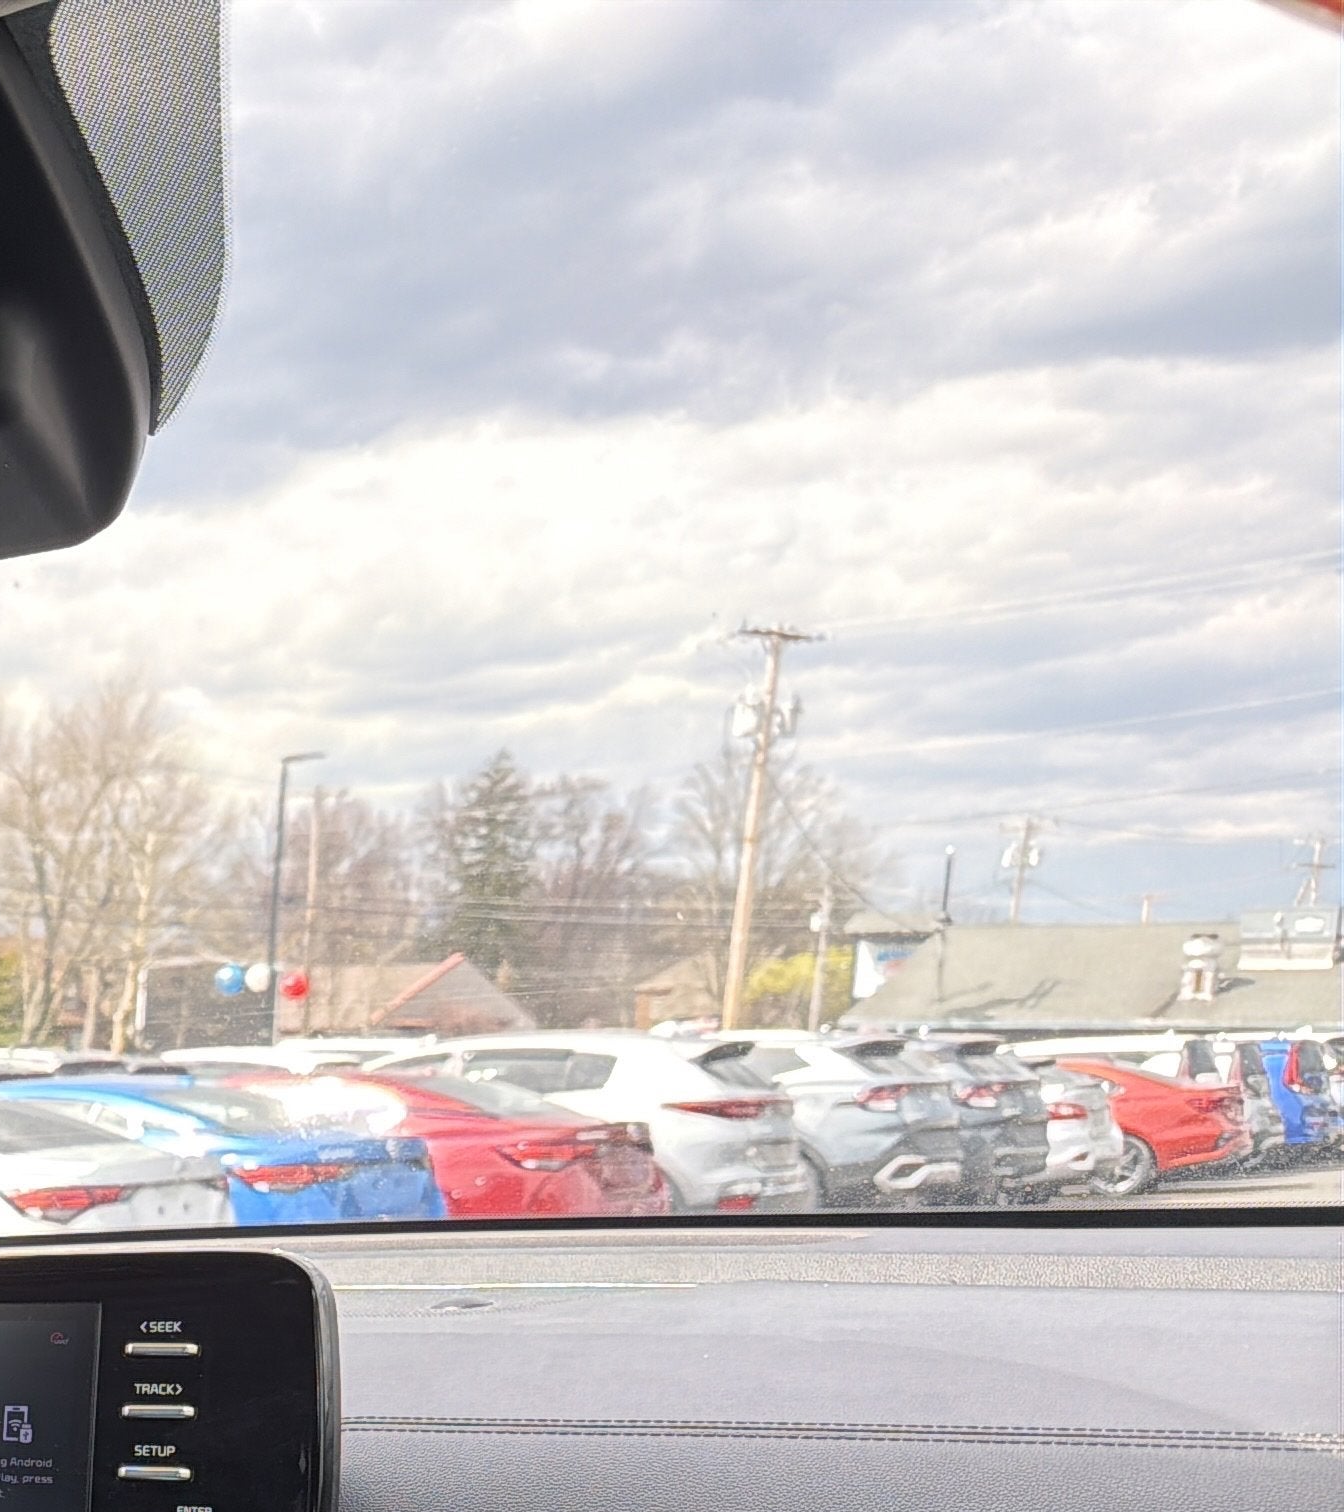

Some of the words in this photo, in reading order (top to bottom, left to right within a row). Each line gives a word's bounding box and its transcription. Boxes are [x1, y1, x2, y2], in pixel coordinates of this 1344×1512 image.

[134, 1446, 175, 1457] SETUP
[10, 1457, 53, 1468] Android
[22, 1474, 53, 1487] press
